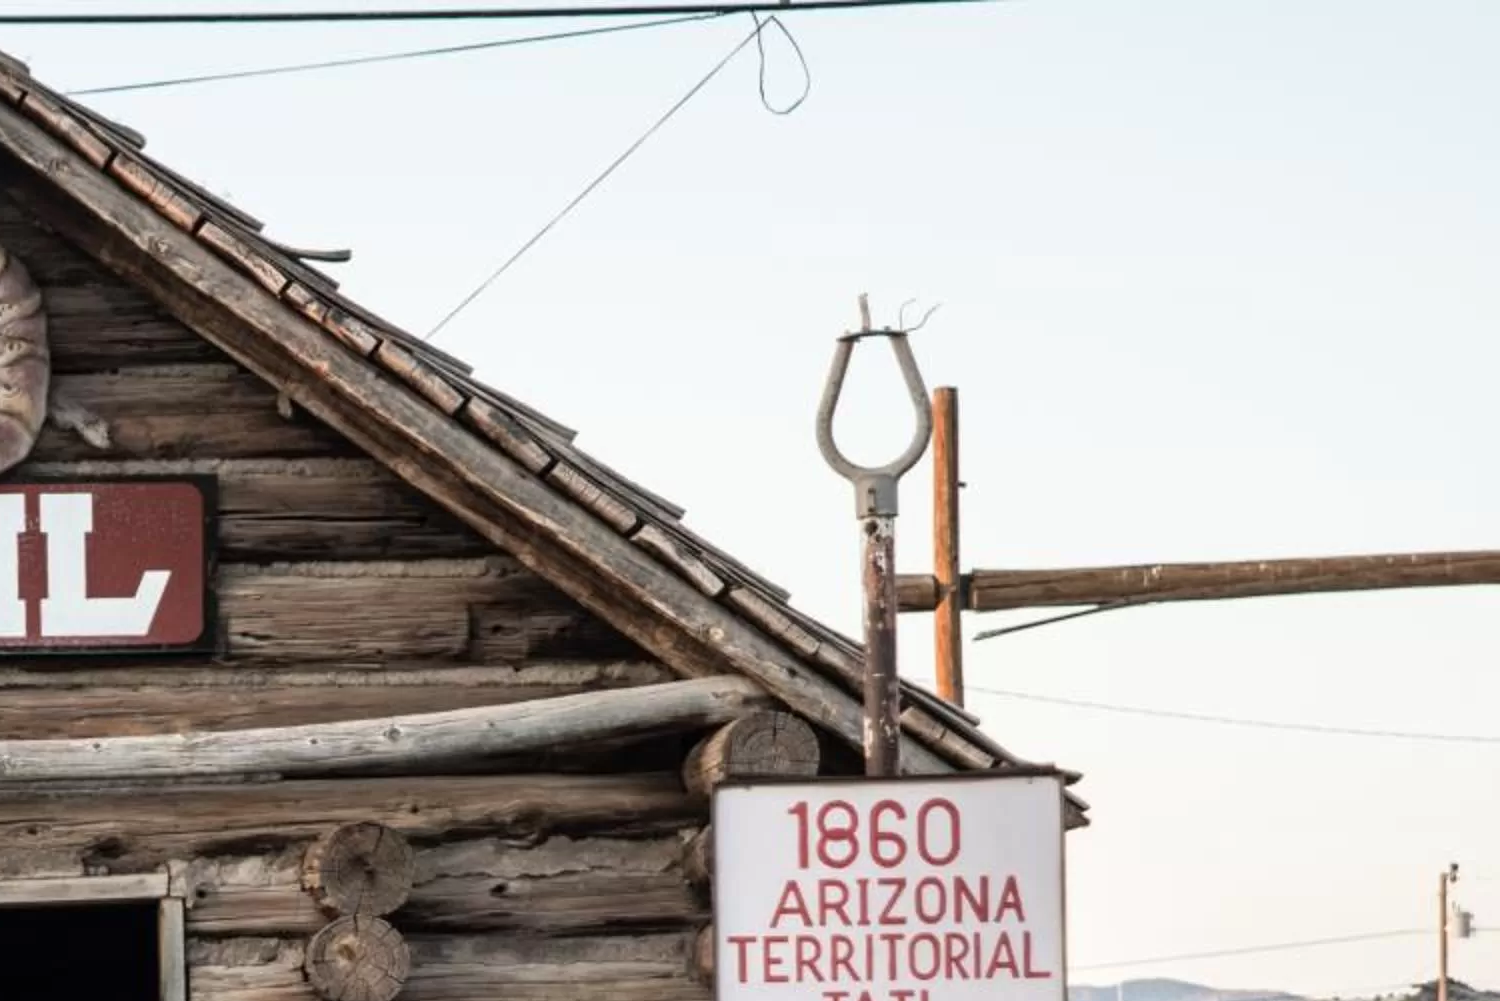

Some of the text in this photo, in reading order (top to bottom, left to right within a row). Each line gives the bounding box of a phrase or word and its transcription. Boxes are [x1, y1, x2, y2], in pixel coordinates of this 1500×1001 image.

[788, 798, 961, 869] 1860
[770, 875, 1025, 928] ARIZONA
[727, 931, 1052, 983] TERRITORIAL
